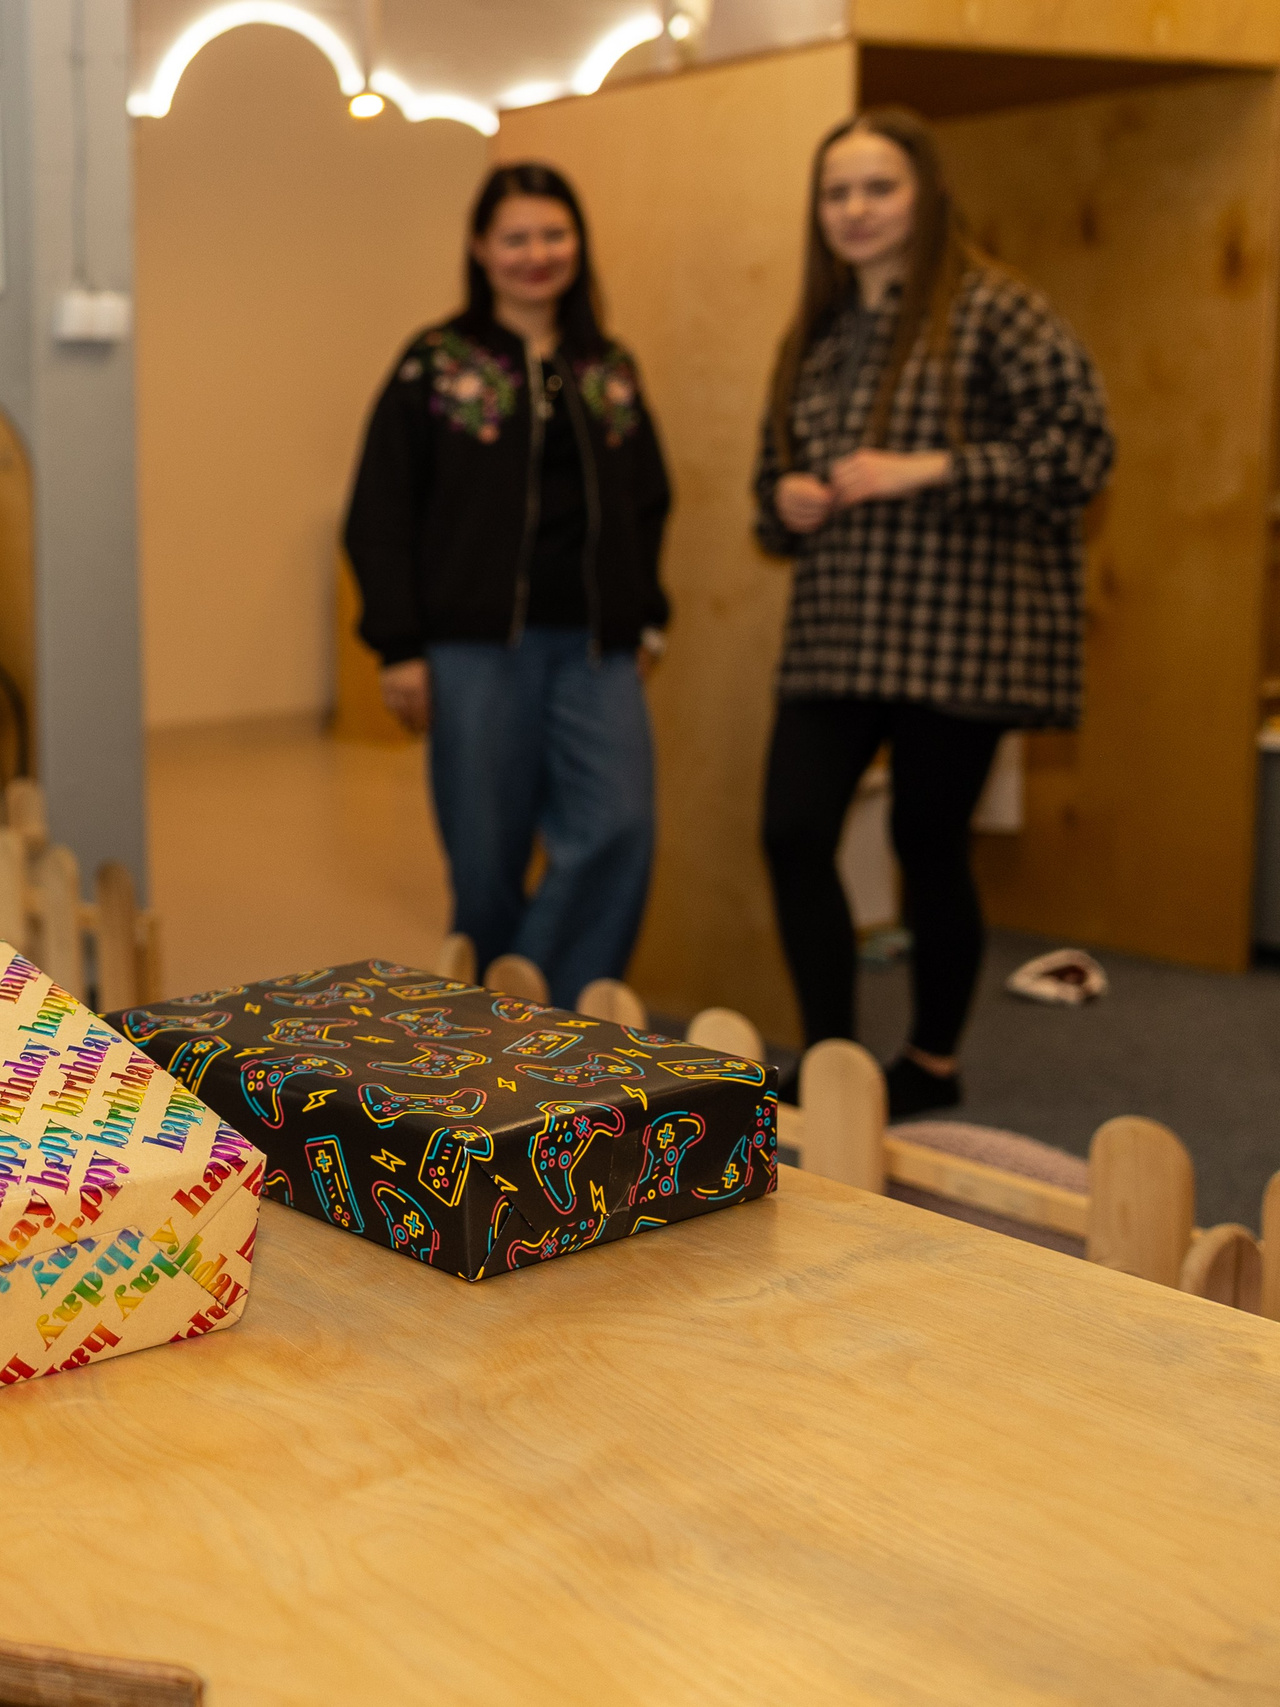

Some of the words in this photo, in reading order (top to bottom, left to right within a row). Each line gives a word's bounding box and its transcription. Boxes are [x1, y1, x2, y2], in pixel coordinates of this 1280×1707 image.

[17, 982, 81, 1039] happ
[40, 1023, 123, 1118] birthday
[84, 1050, 164, 1150] birthday
[170, 1116, 255, 1219] happ
